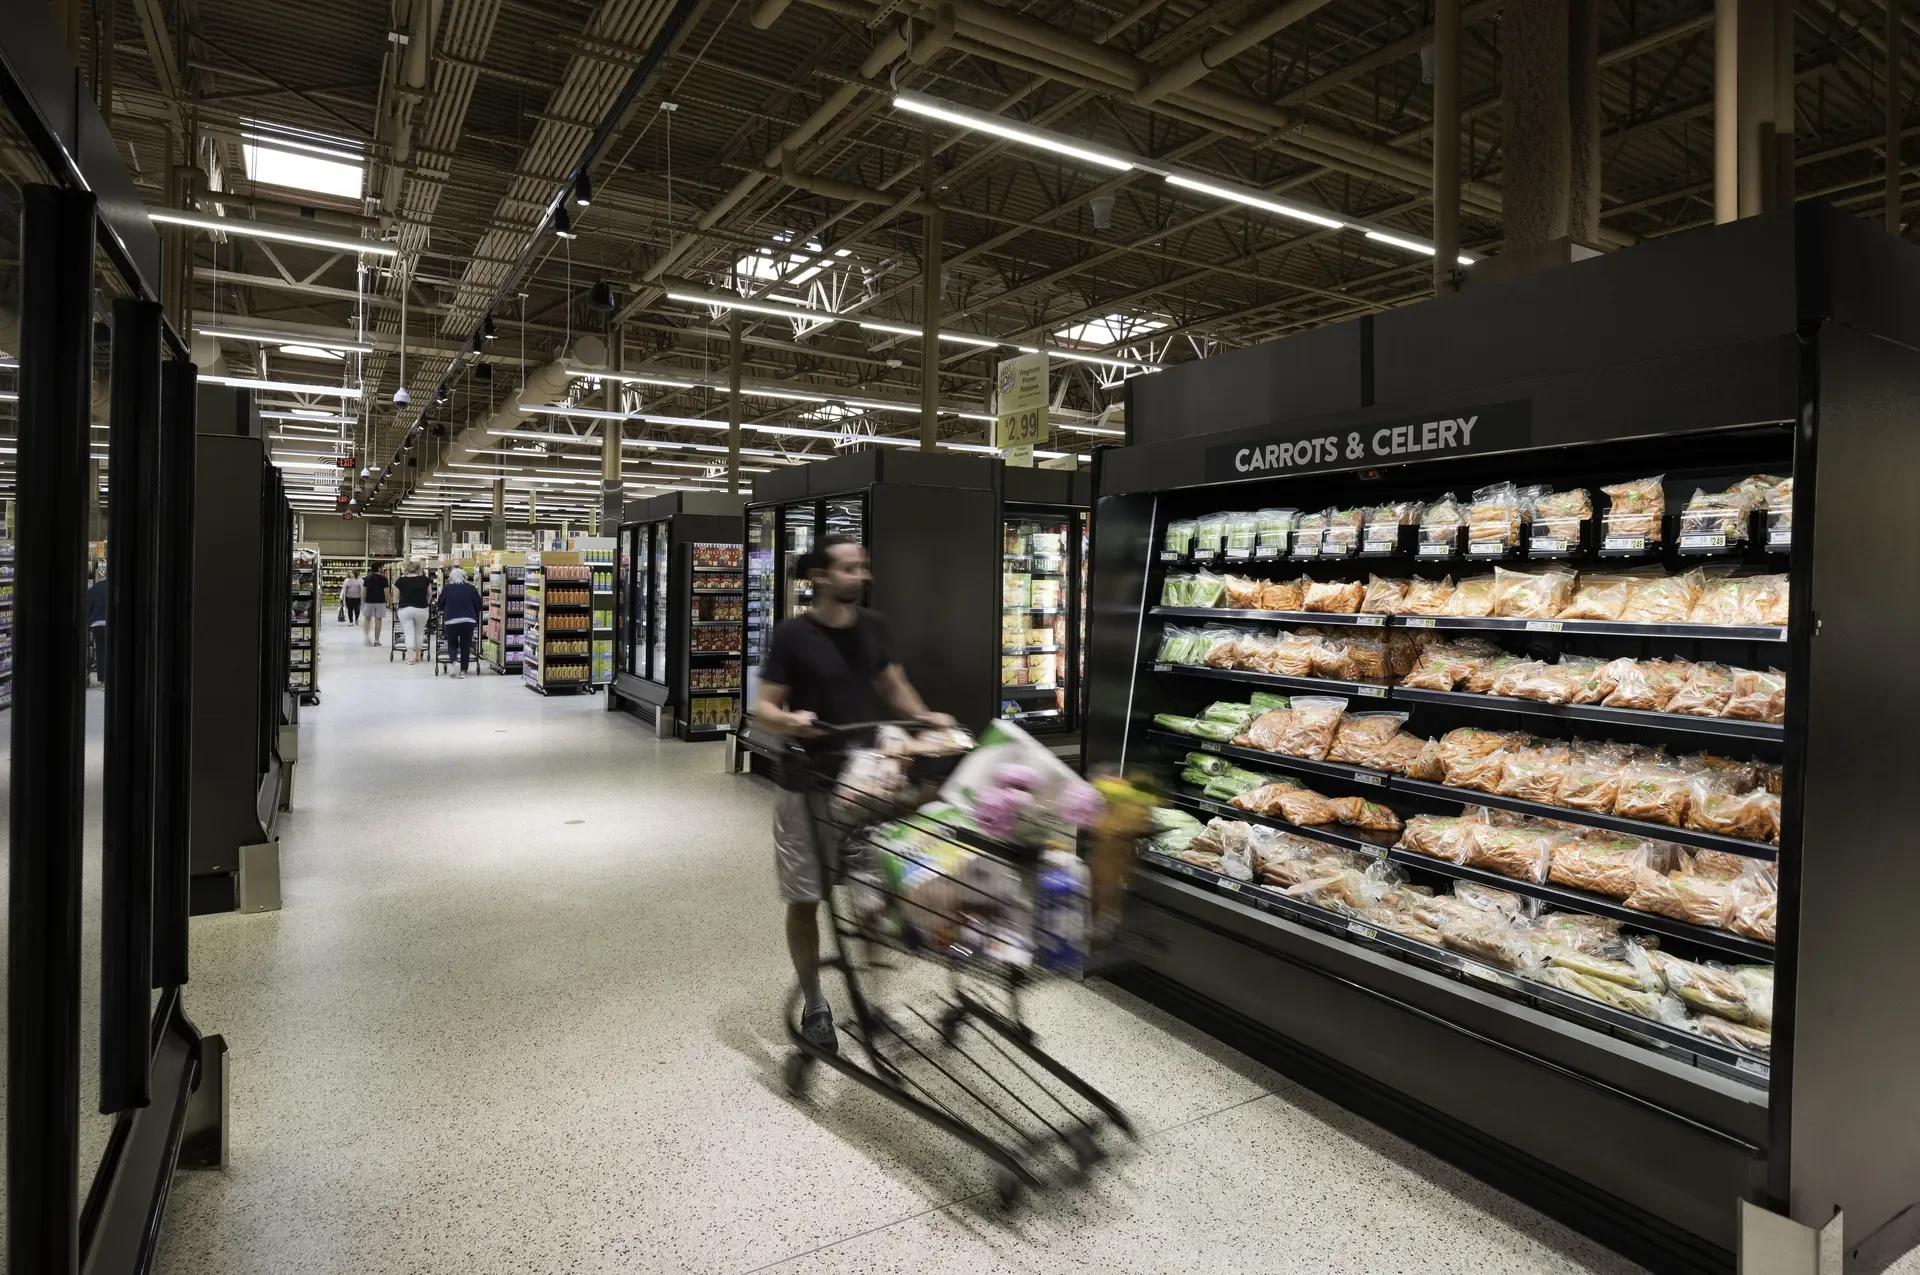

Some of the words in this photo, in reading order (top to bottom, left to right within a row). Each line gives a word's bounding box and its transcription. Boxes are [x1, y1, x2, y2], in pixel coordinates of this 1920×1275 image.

[1019, 366, 1040, 376] Wegmans
[1022, 376, 1037, 384] Frozen
[1020, 384, 1039, 392] Potatoes
[1005, 412, 1037, 441] $2.99
[1235, 436, 1338, 472] CARROTS
[1345, 431, 1365, 459] &
[1372, 415, 1479, 456] CELERY
[340, 458, 353, 467] EXIT
